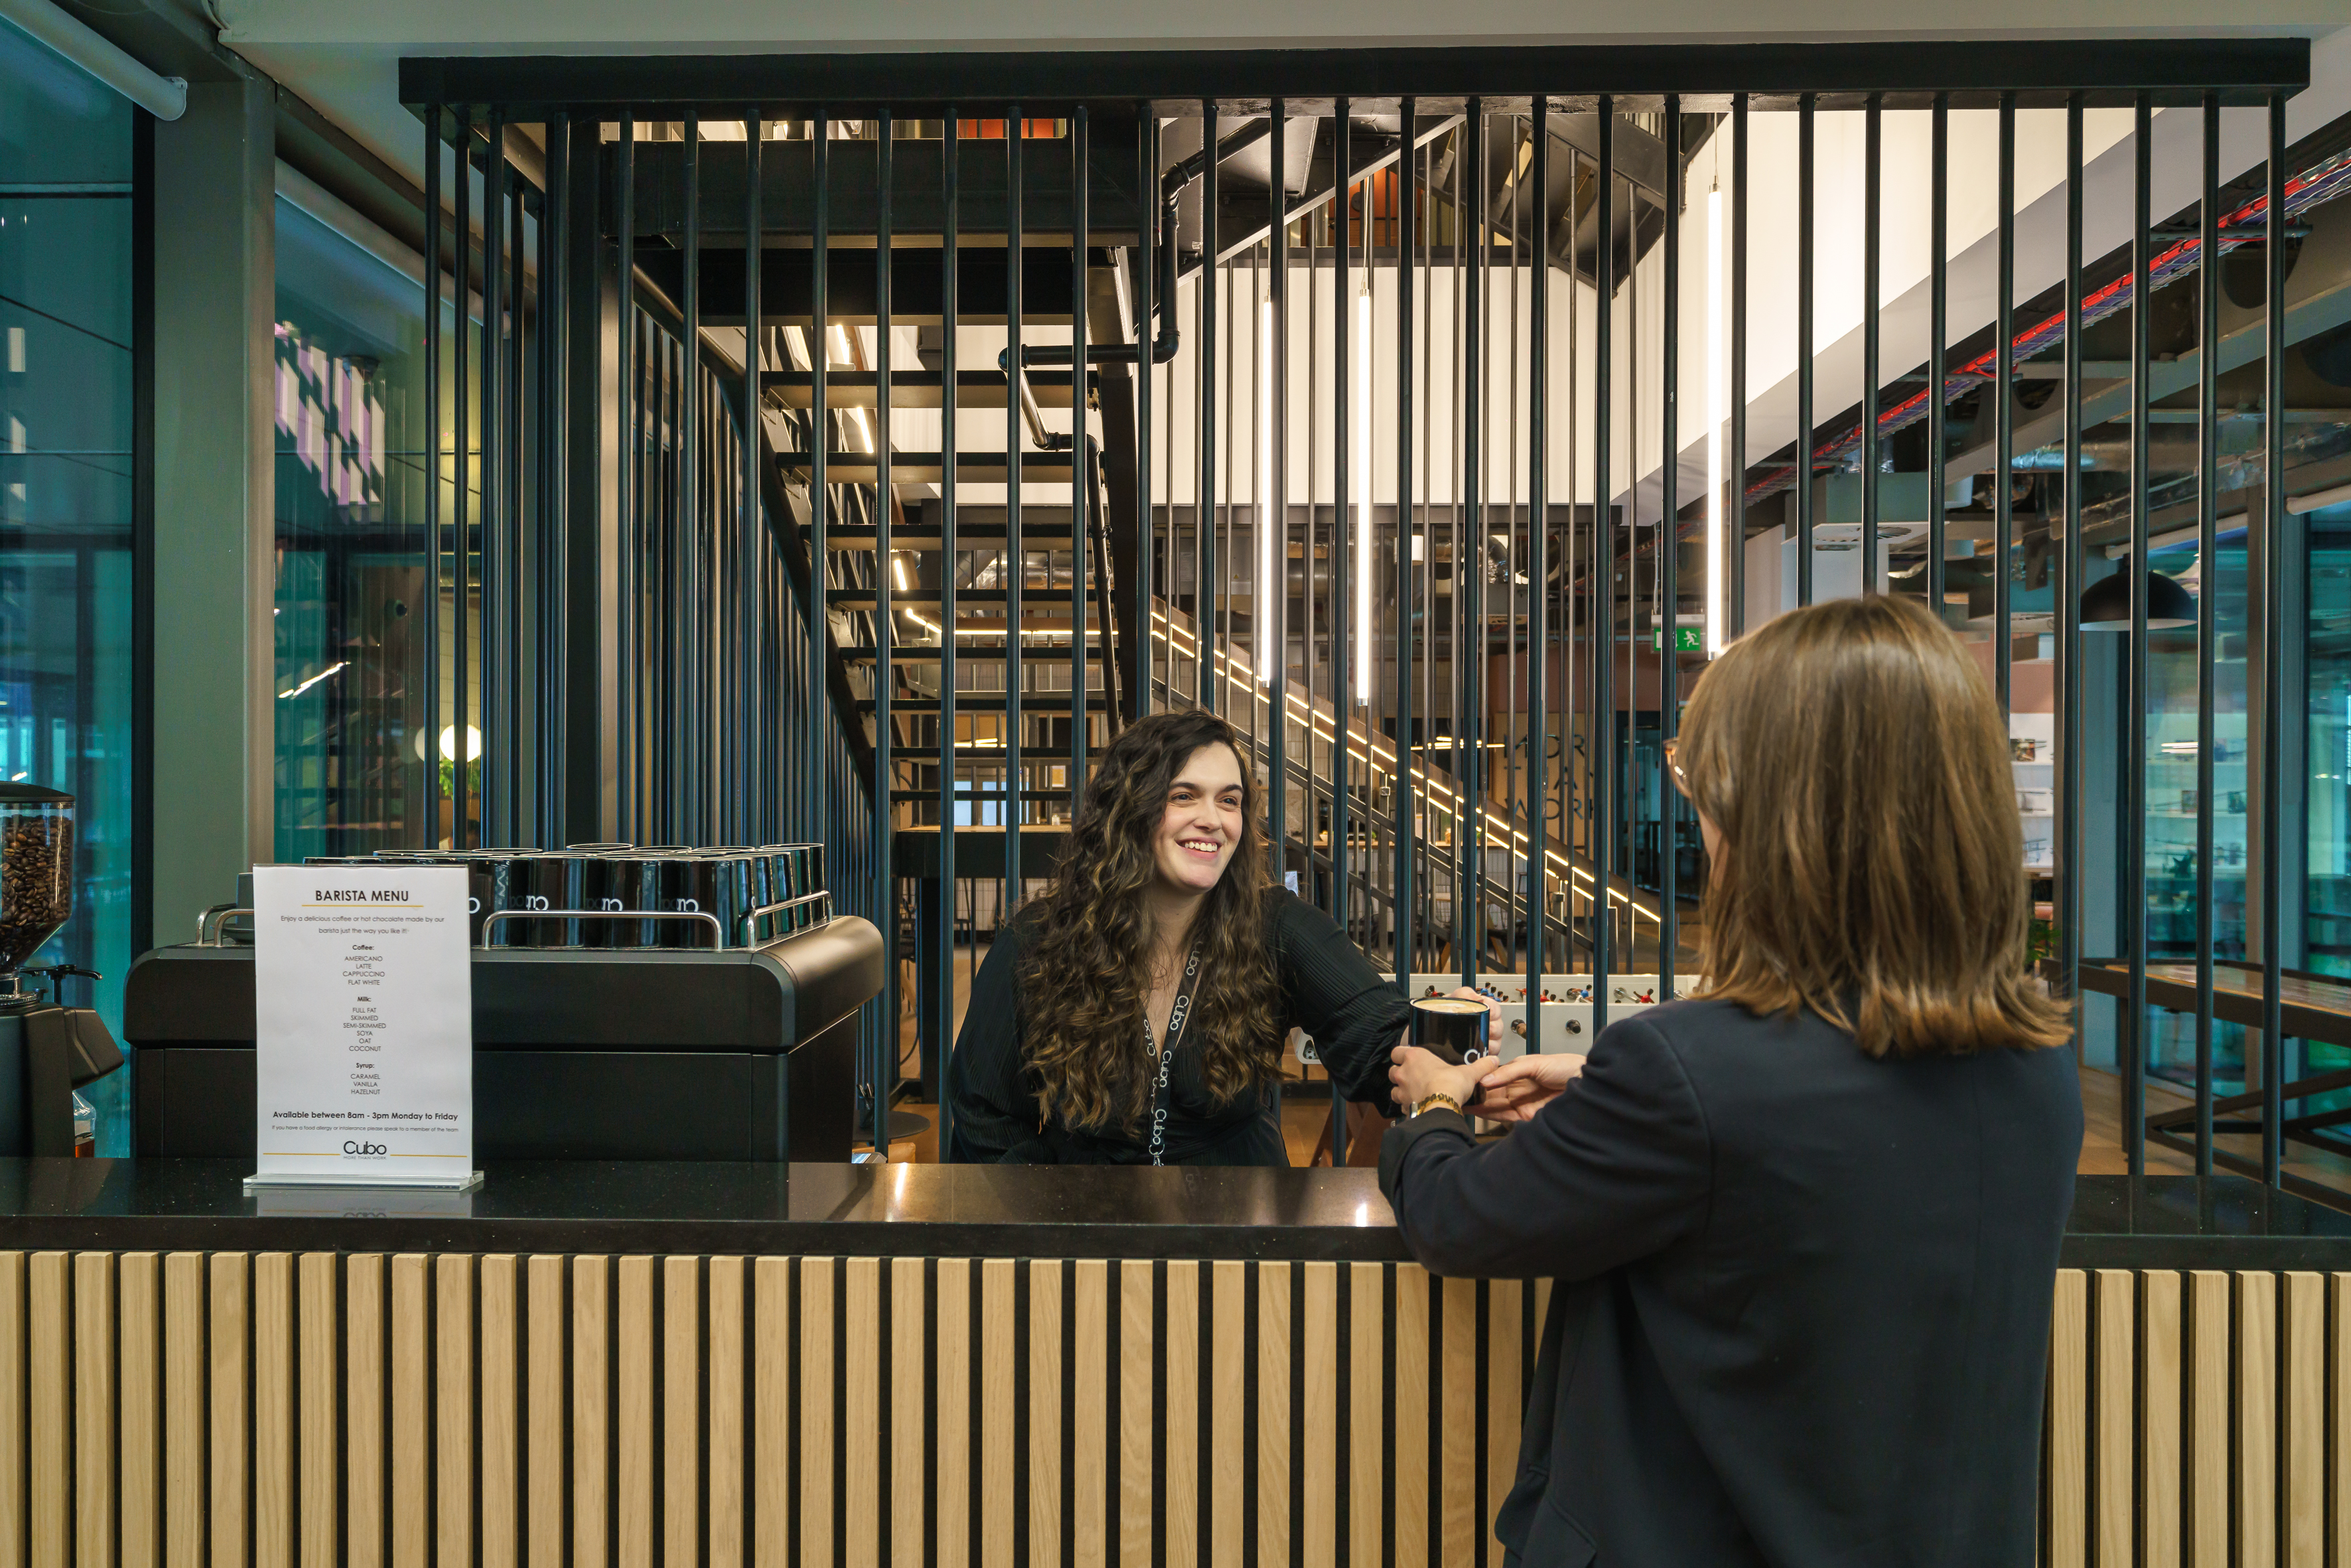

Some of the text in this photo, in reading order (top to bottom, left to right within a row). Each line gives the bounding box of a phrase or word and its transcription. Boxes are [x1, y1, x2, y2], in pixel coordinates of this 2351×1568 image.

[315, 890, 409, 902] BARISTA MENU
[1186, 941, 1203, 976] Cubo
[1170, 995, 1189, 1031] Cubo
[1143, 1019, 1156, 1056] Cubo
[1159, 1050, 1172, 1088] Cubo
[391, 1113, 423, 1121] Monday
[435, 1113, 459, 1121] Friday
[1152, 1109, 1167, 1145] Cubo
[343, 1140, 388, 1155] Cubo
